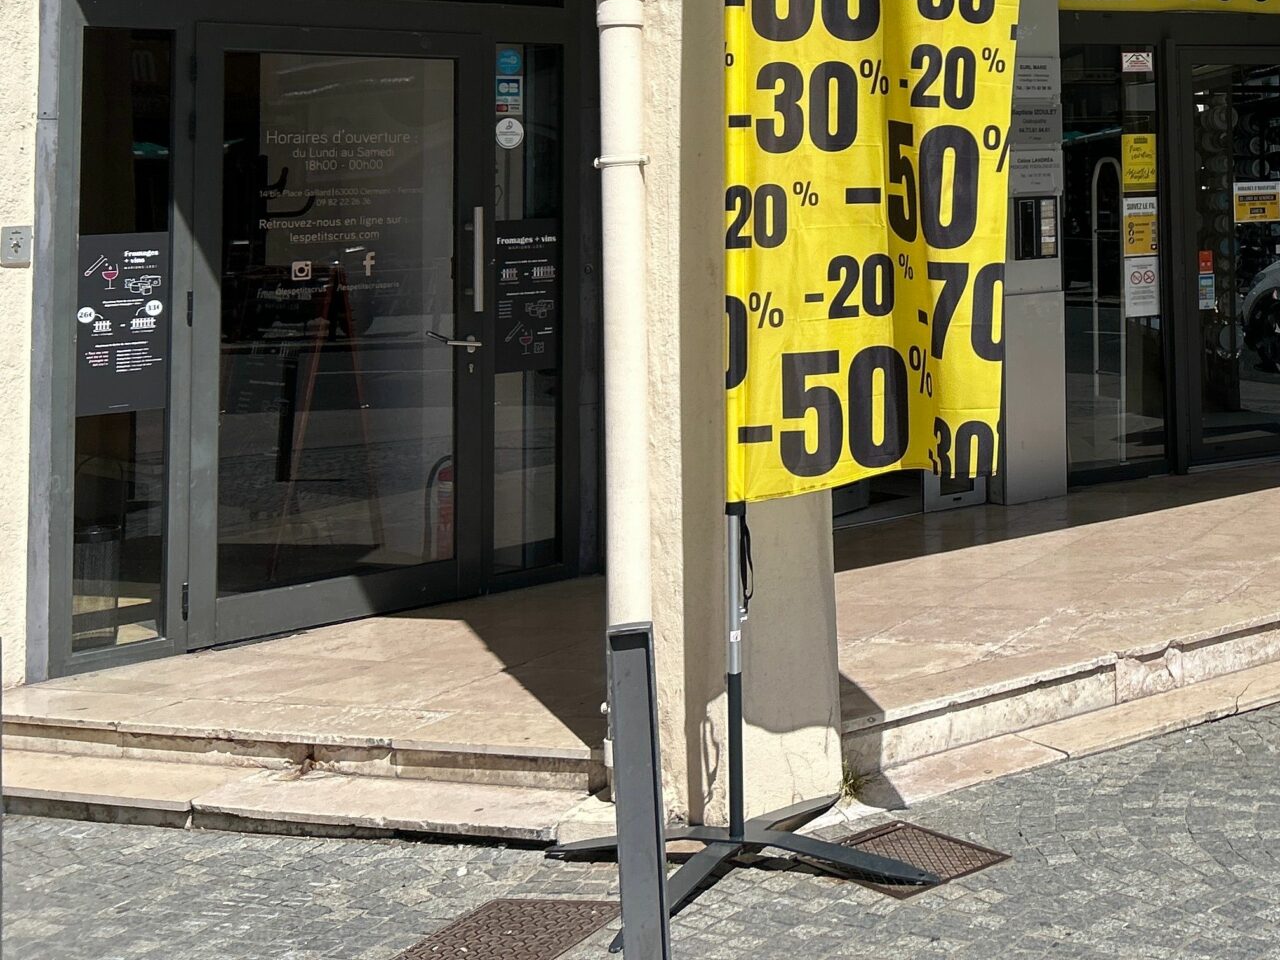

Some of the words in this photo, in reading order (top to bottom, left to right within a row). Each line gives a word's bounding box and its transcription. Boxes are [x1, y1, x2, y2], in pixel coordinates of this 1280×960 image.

[899, 43, 1006, 111] -20%
[728, 58, 889, 154] -30%
[266, 129, 328, 144] Horaires
[332, 128, 411, 144] d'ouverture
[292, 147, 306, 158] du
[309, 147, 338, 158] Lundi
[341, 149, 354, 157] au
[357, 146, 395, 157] Samedi
[305, 160, 337, 171] 18h00
[348, 159, 383, 170] 00h00
[259, 218, 341, 230] Retrouvez-nous
[360, 216, 384, 227] ligne
[386, 216, 402, 225] sur
[497, 236, 533, 246] Fromages
[541, 235, 556, 243] vins
[804, 253, 913, 320] -20%
[737, 345, 933, 478] -50%
